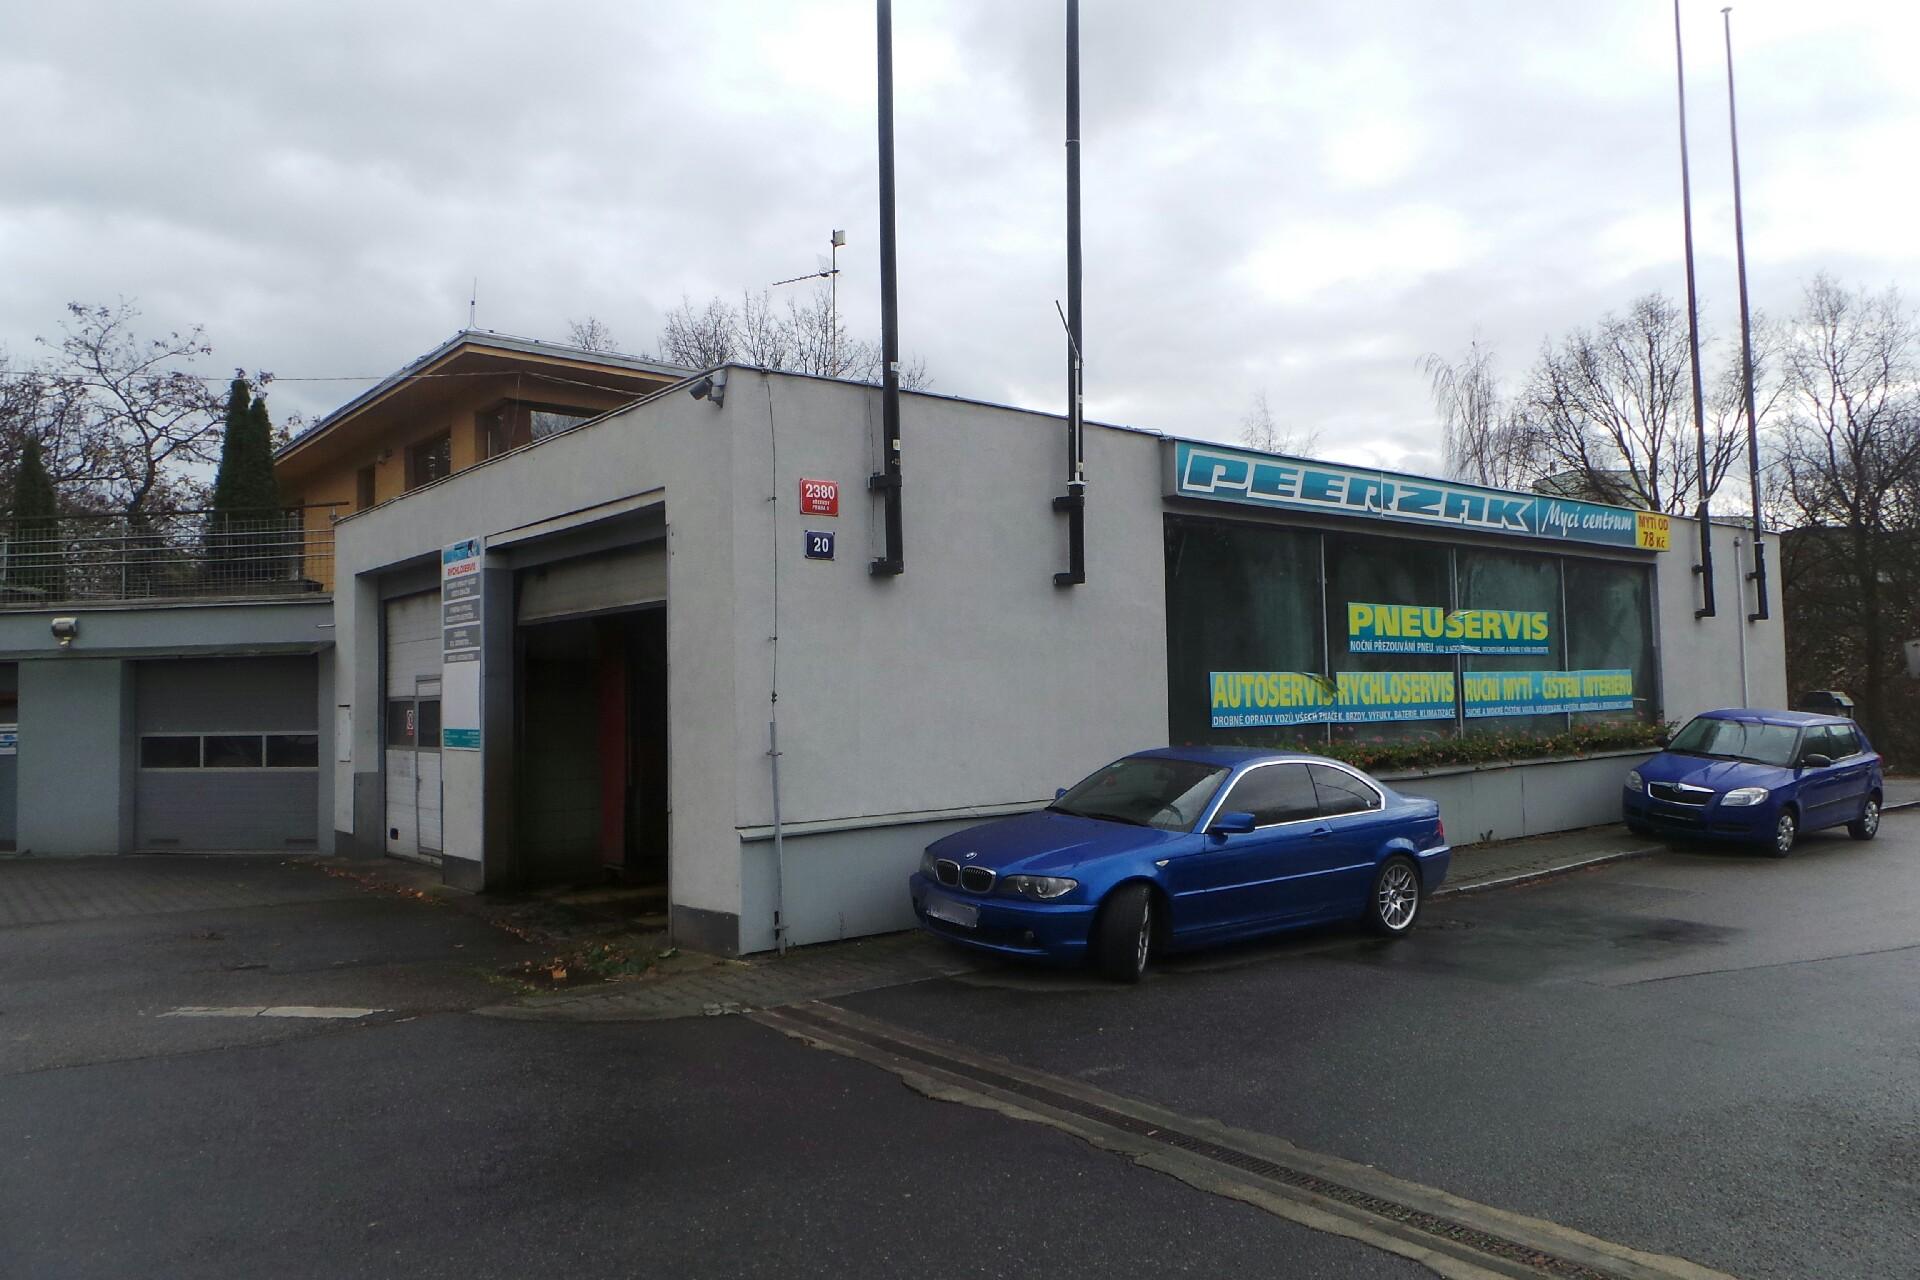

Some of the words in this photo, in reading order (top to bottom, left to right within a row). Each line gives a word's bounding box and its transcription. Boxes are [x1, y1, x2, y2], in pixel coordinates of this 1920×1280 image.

[805, 483, 835, 499] 2380
[1182, 448, 1536, 532] PEERZAK
[1541, 500, 1580, 537] Mycí
[1582, 511, 1632, 531] centrum
[1659, 518, 1669, 531] OD
[813, 537, 829, 552] 20
[1642, 531, 1655, 547] 78
[1349, 605, 1549, 641] PNEUSERVIS
[1350, 640, 1373, 652] NOČNÍ
[1374, 640, 1416, 652] PŘEZOUVÁNÍ
[1417, 642, 1434, 652] PNEU
[1212, 674, 1334, 709] AUTOSERVIS
[1338, 673, 1456, 706] RYCHLOSERVIS
[1213, 714, 1244, 727] DROBNÉ
[1245, 714, 1273, 725] OPRAVY
[1275, 711, 1293, 723] VOZŮ
[1295, 711, 1317, 723] VŠECH
